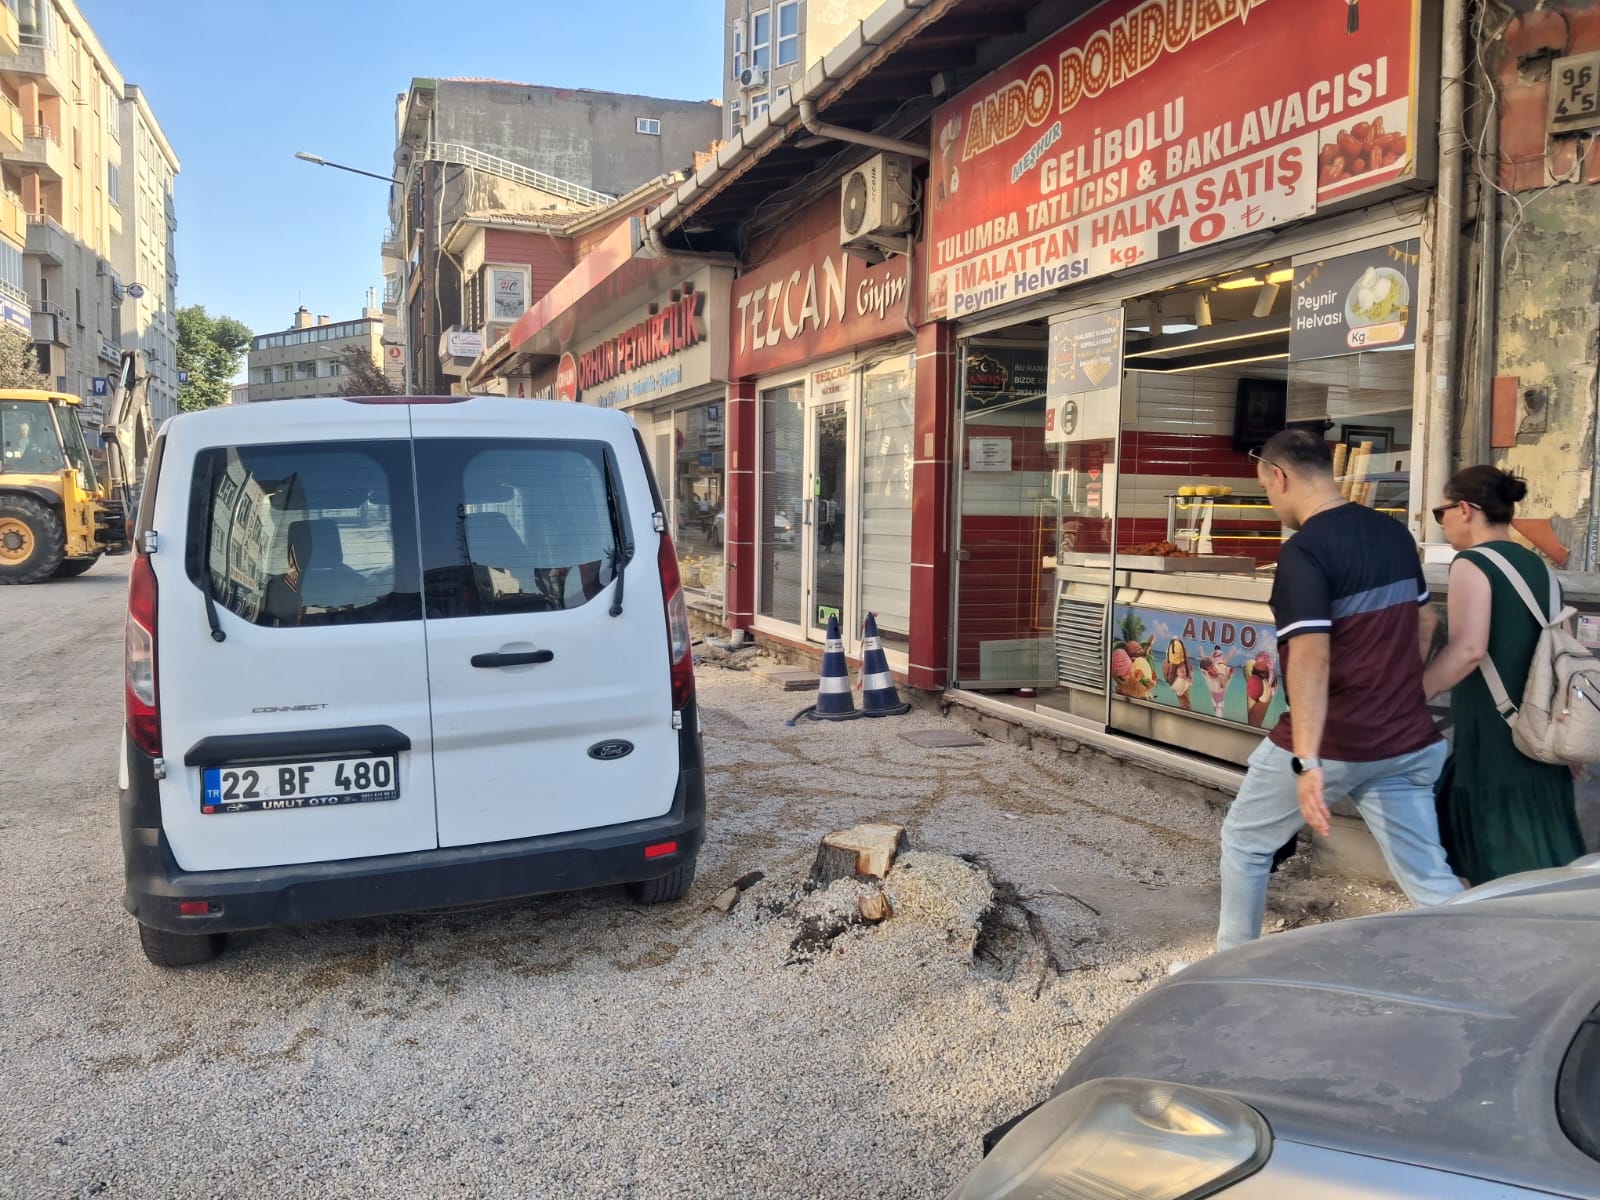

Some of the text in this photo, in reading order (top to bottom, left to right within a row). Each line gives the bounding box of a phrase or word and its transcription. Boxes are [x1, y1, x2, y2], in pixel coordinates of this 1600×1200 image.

[1562, 65, 1593, 86] 96
[1570, 84, 1584, 102] F
[961, 64, 1055, 162] ANDO
[936, 56, 1388, 266] TULUMBA TATLICISI & BAKLAVACISI
[1011, 121, 1062, 184] MEŞHUR
[1040, 95, 1185, 195] GELİBOLU
[954, 146, 1304, 293] İMALATTAN HALKA SATIŞ
[737, 252, 849, 360] TEZCAN
[954, 257, 1089, 315] Peynir Helvası
[1297, 289, 1338, 312] Peynir
[577, 281, 701, 391] ORHUN PEYNİRCİLİK
[1296, 312, 1342, 331] Helvası
[1351, 331, 1366, 344] Kg
[1182, 617, 1257, 649] ANDO
[251, 703, 329, 714] CONNECT
[208, 760, 391, 801] TR 22 BF 480
[262, 796, 339, 810] UMUT OTO
